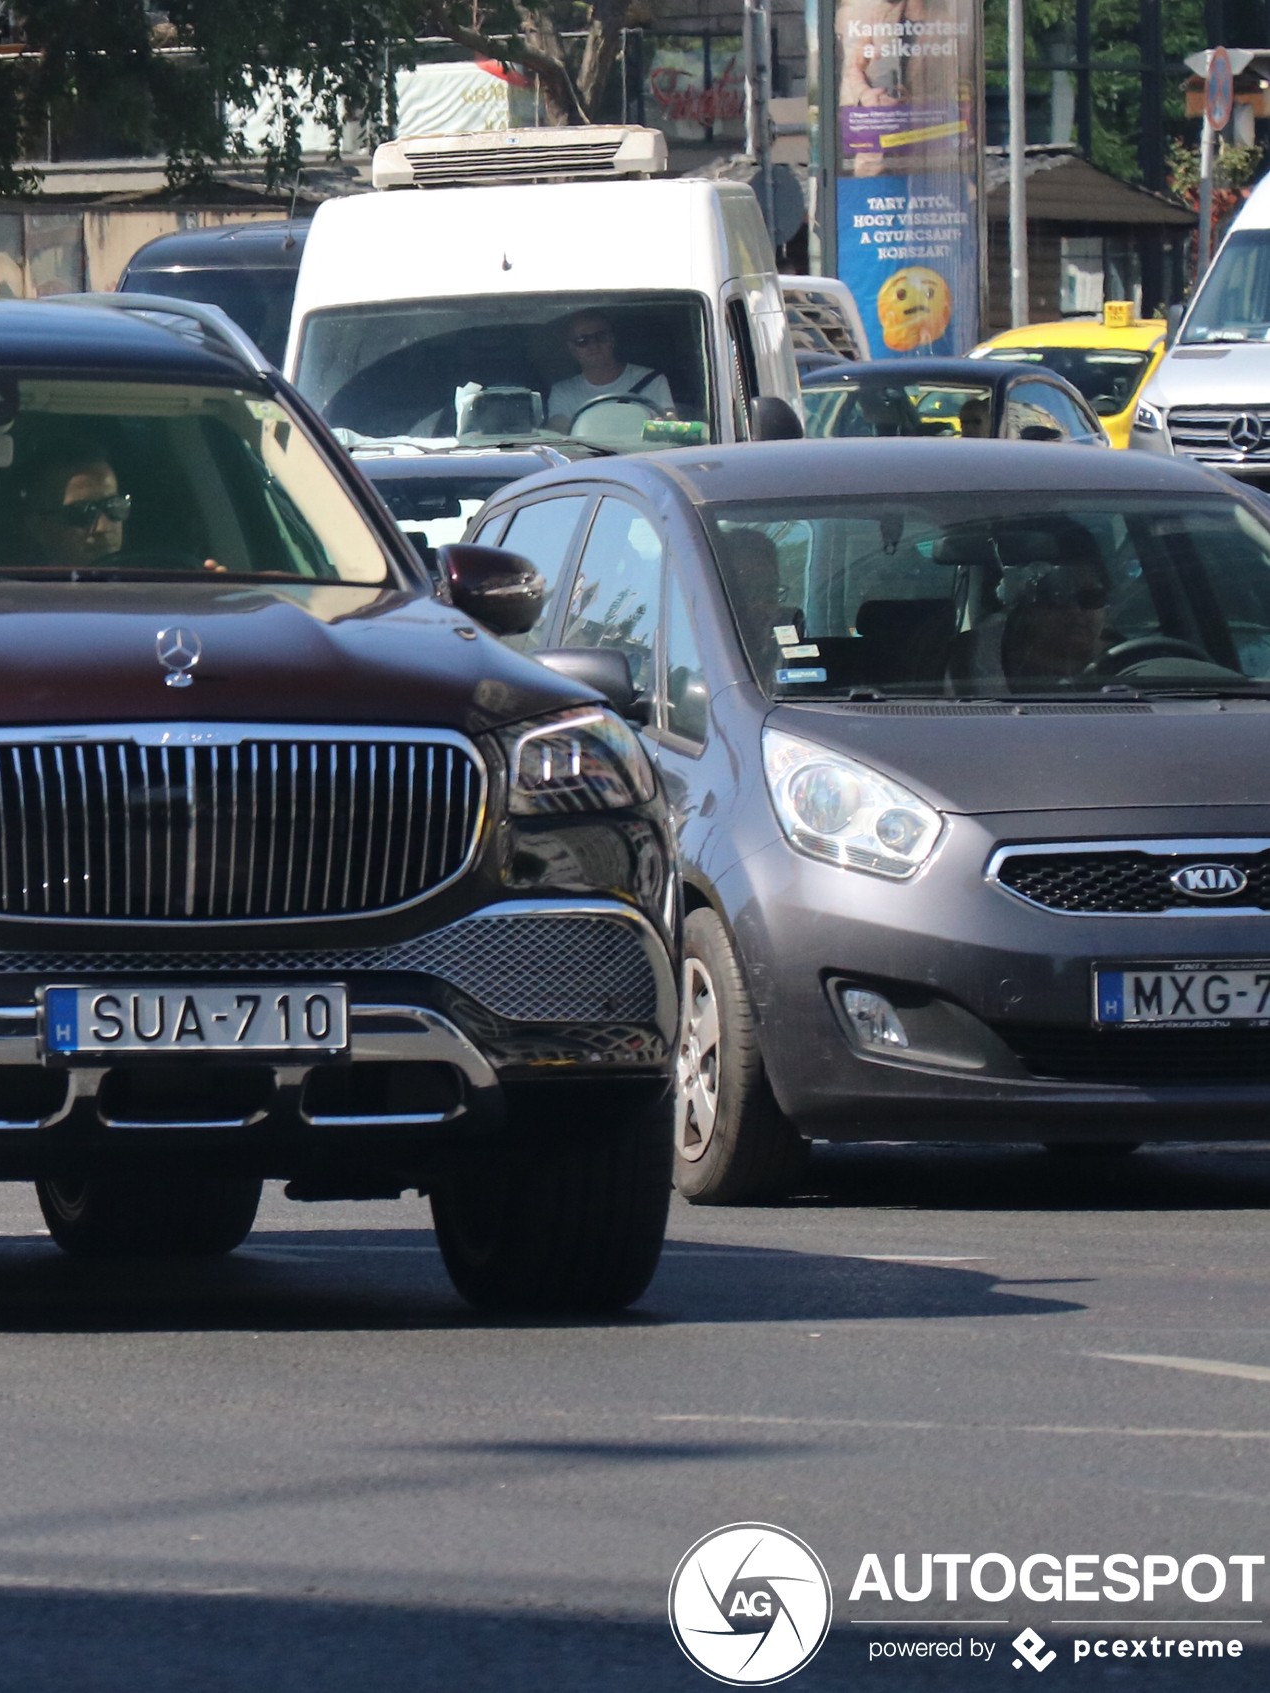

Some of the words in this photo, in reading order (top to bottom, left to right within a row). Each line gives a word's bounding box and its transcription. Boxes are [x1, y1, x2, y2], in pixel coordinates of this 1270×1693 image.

[847, 19, 969, 38] Kamatoztasd
[862, 45, 875, 58] a
[867, 197, 906, 211] TART
[853, 214, 895, 228] HOGY
[860, 232, 871, 244] A
[1184, 869, 1237, 890] KIA
[1105, 1001, 1117, 1014] H
[55, 1024, 71, 1041] H
[89, 993, 332, 1043] SUA-710
